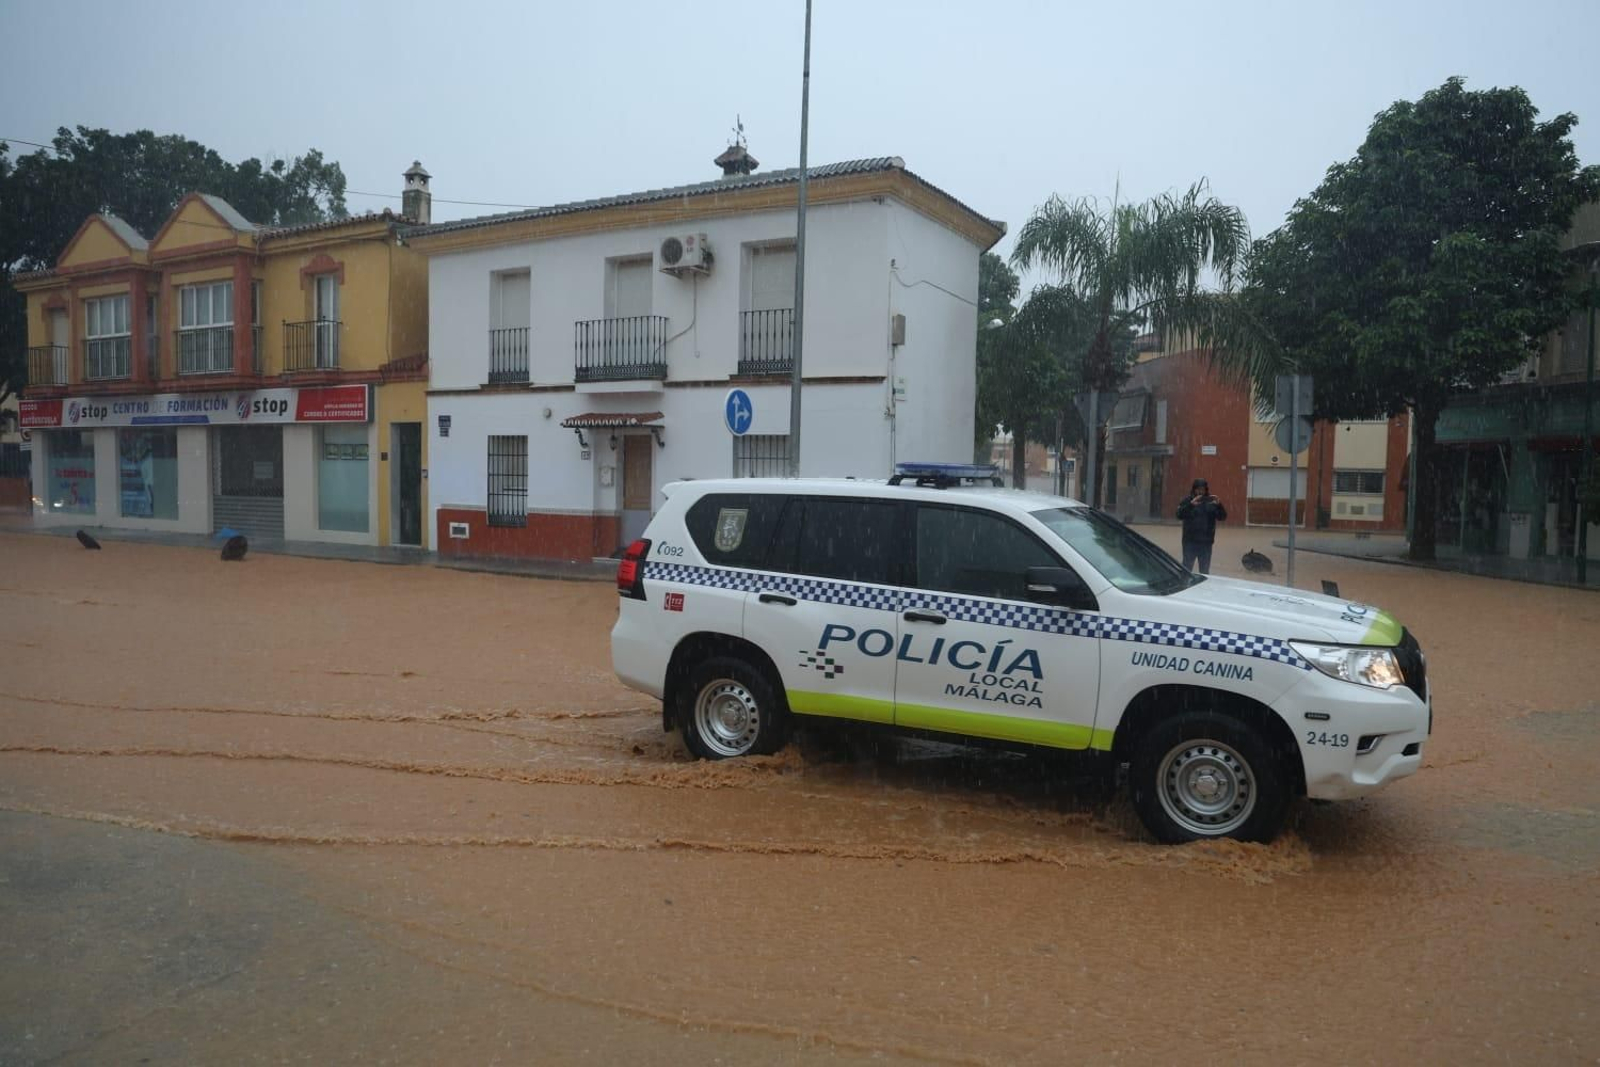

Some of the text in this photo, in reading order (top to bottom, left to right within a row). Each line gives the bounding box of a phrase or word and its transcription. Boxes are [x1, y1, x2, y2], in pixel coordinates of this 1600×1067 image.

[81, 403, 108, 421] stop
[112, 401, 149, 414] CENTRO
[167, 396, 228, 413] FORMACIÓN
[253, 398, 289, 417] stop
[664, 546, 684, 557] 092
[817, 623, 1044, 680] POLICÍA
[1131, 651, 1254, 681] UNIDAD CANINA
[969, 672, 1044, 694] LOCAL
[944, 683, 1043, 709] MÁLAGA
